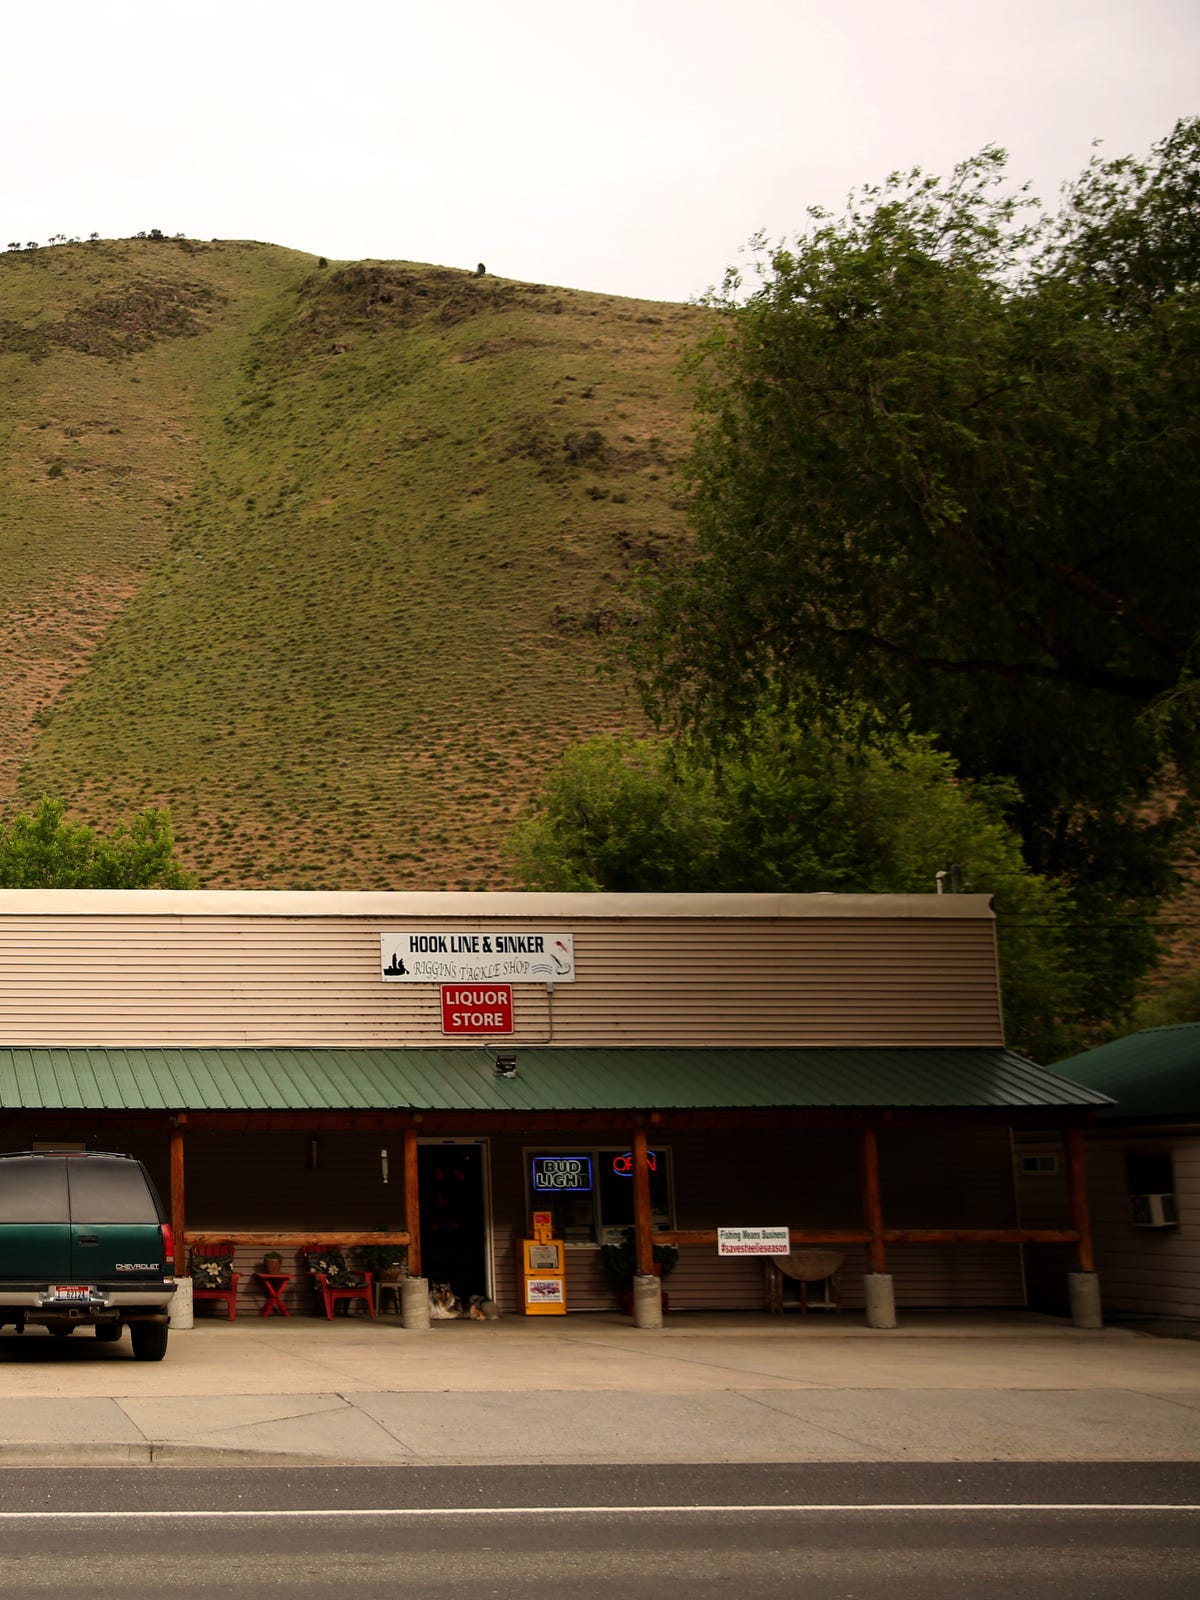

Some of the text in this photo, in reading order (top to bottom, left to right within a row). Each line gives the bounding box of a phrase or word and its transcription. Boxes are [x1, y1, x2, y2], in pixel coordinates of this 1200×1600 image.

[409, 936, 545, 953] HOOK LINE & SINKER
[414, 958, 530, 981] RIGGINS TACKLE SHOP
[446, 991, 508, 1006] LIQUOR
[452, 1012, 504, 1026] STORE
[544, 1160, 581, 1174] BUD
[536, 1172, 588, 1187] LIGHT
[720, 1230, 787, 1241] Fishing Means Business
[115, 1263, 160, 1271] CHEVROLET
